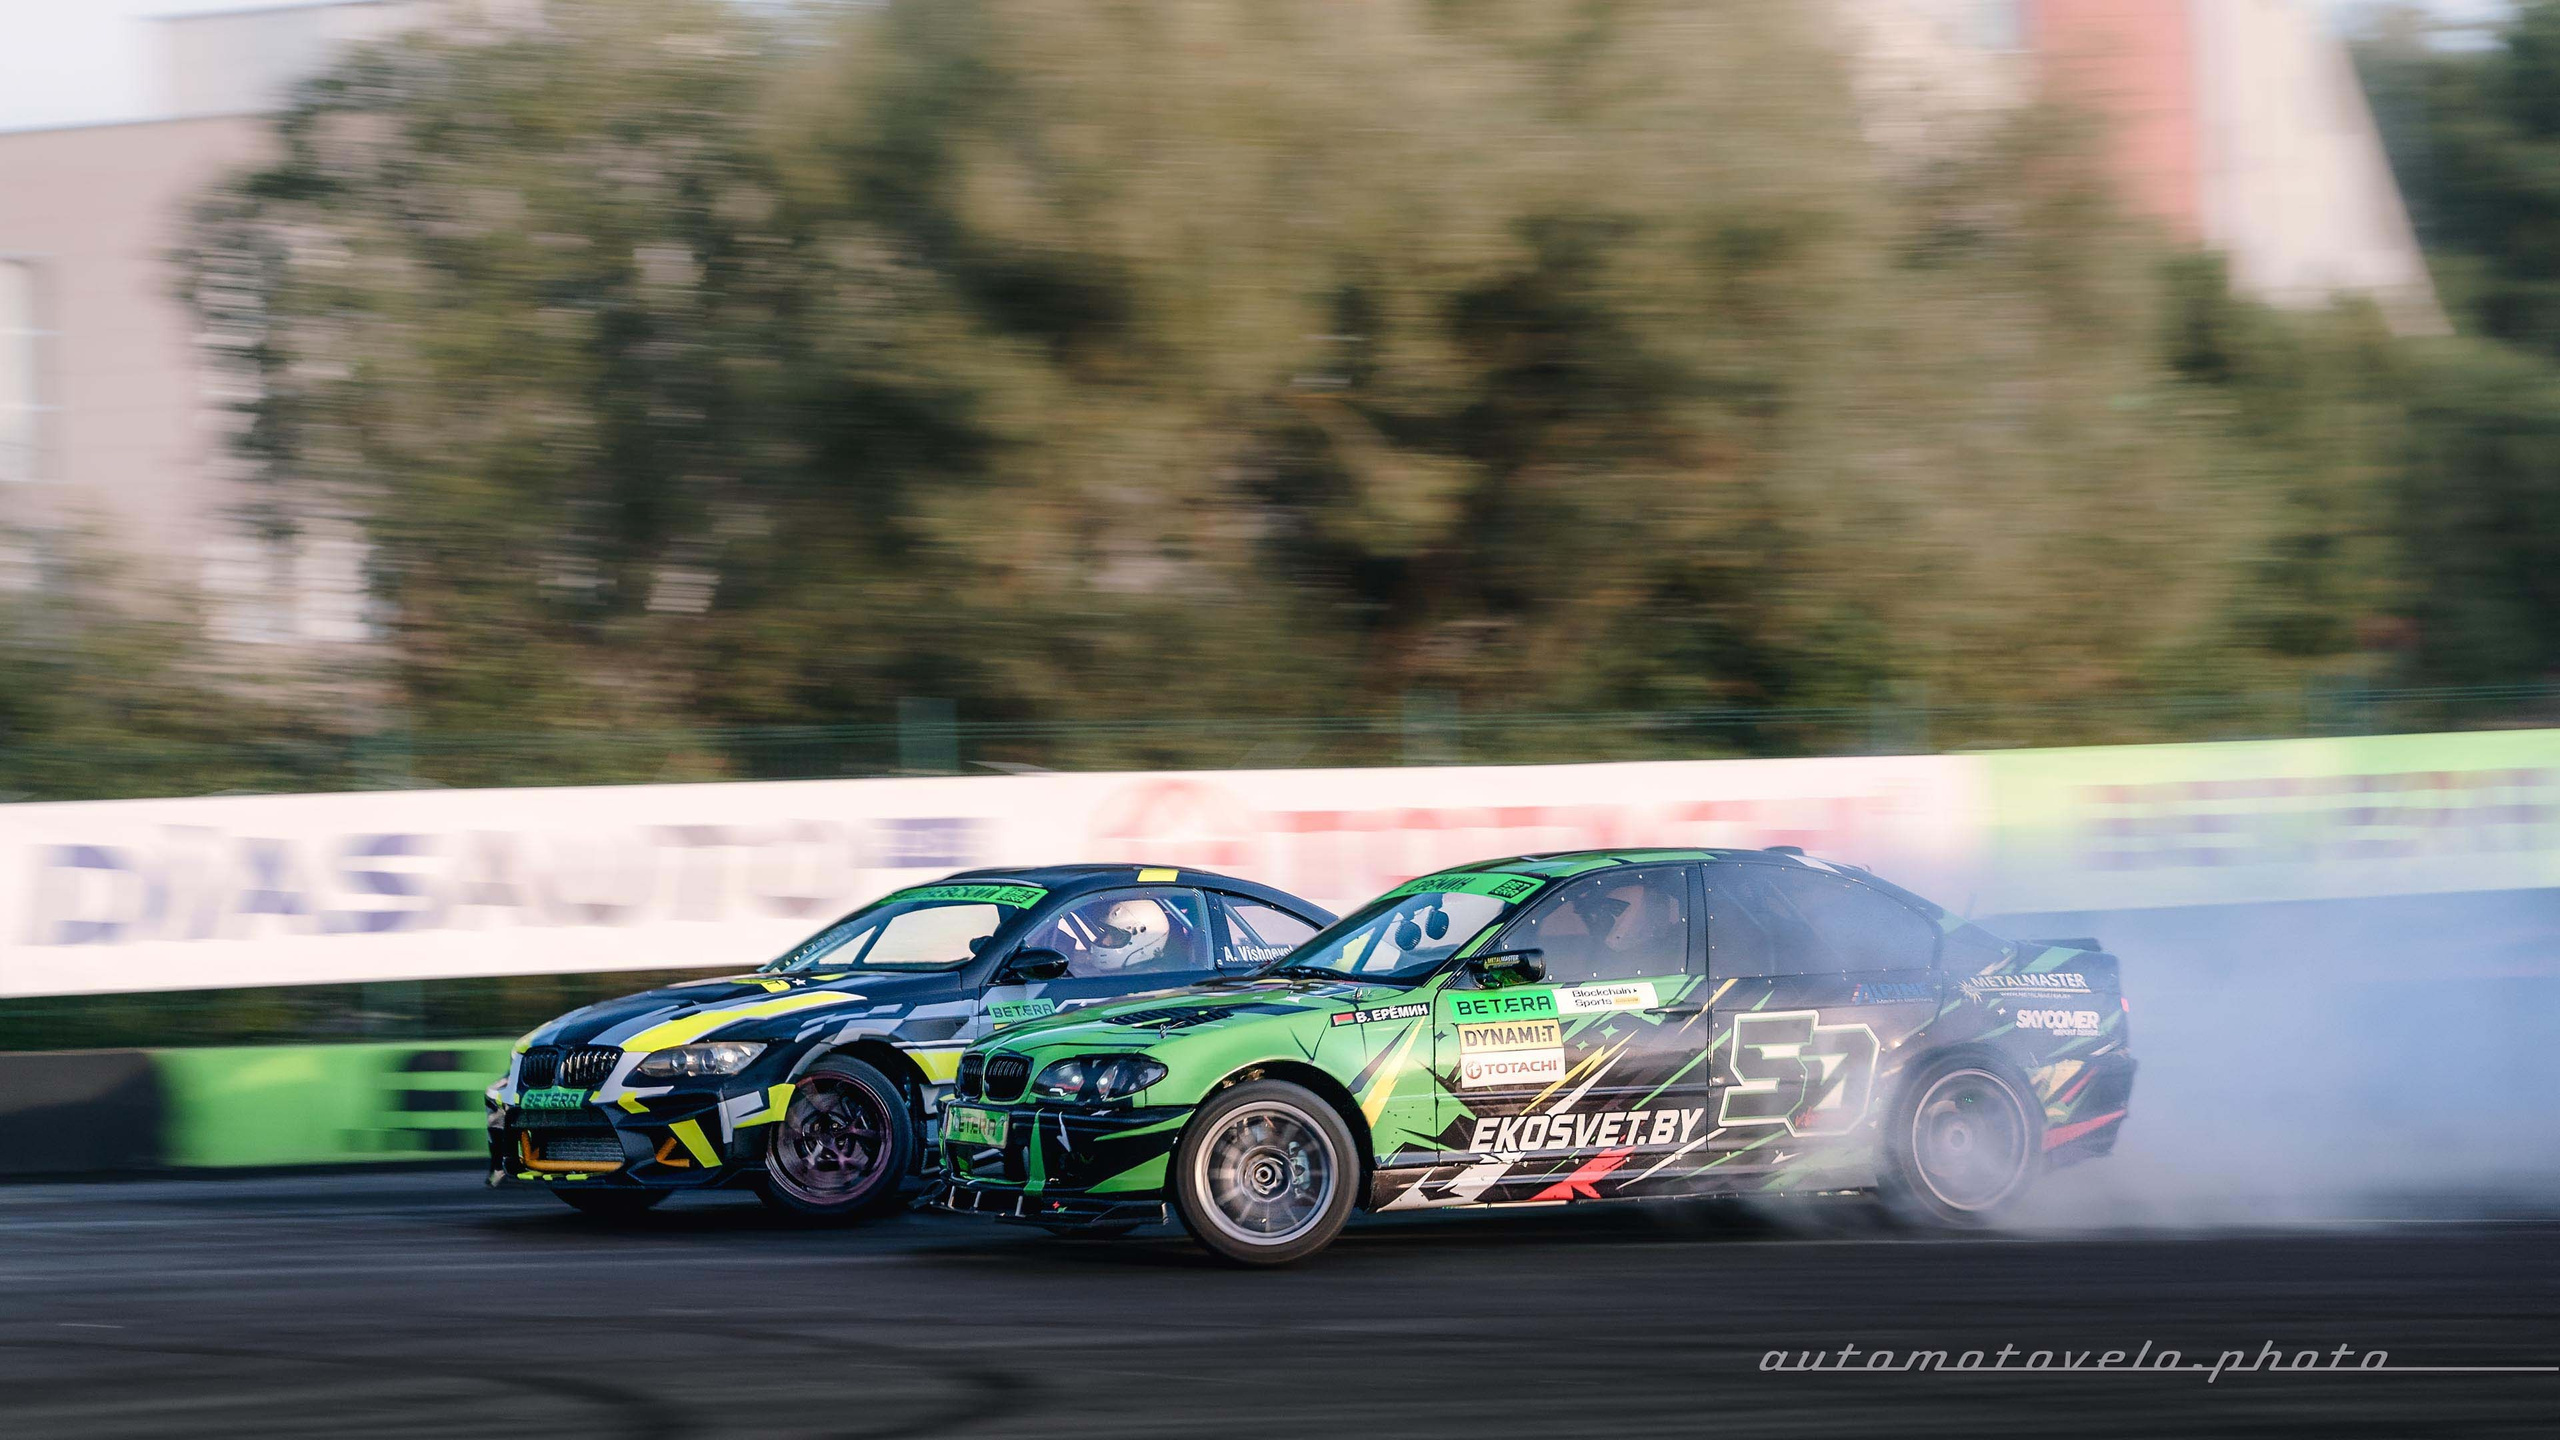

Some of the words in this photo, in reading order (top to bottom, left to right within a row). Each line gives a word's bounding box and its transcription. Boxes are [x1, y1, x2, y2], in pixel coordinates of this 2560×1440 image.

[1223, 945, 1238, 962] A.
[1970, 973, 2088, 988] METALMASTER
[1572, 987, 1631, 998] Blockchain
[1457, 996, 1551, 1015] BETERA
[1575, 998, 1612, 1007] Sports
[1372, 1004, 1428, 1020] ЕРЁМИН
[1485, 1060, 1557, 1074] TOTACHI
[1469, 1108, 1704, 1153] EKOSVET.BY
